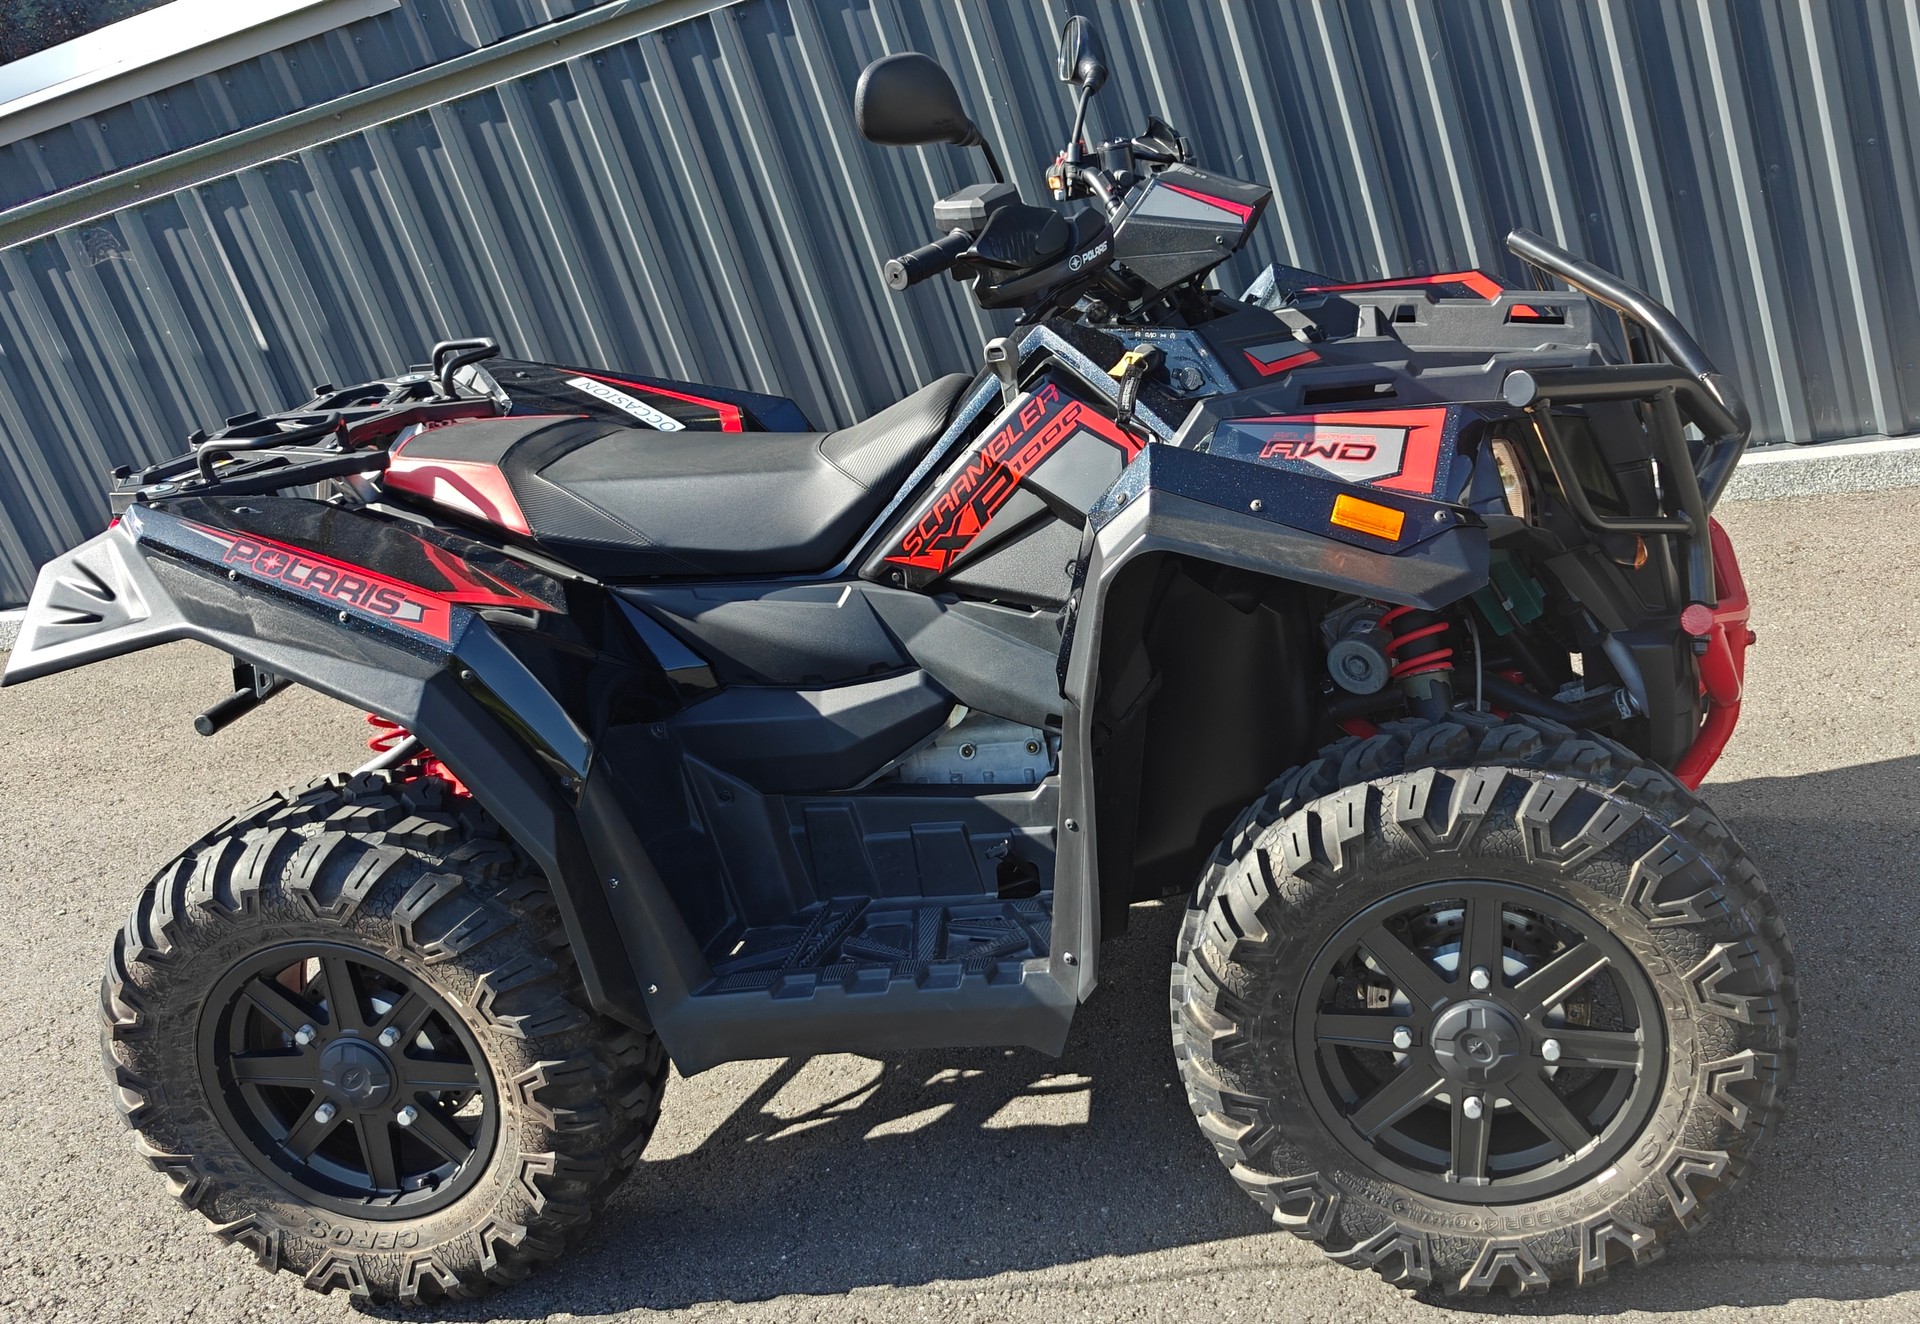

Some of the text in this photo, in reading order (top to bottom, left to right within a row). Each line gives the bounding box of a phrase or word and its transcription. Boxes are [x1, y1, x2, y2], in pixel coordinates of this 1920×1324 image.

[578, 381, 676, 431] OCCASION
[1013, 404, 1082, 472] 1000
[1259, 439, 1379, 464] AWD
[902, 383, 1059, 558] SCRAMBLER
[225, 538, 406, 618] POLARIS
[303, 1217, 420, 1250] CEROS
